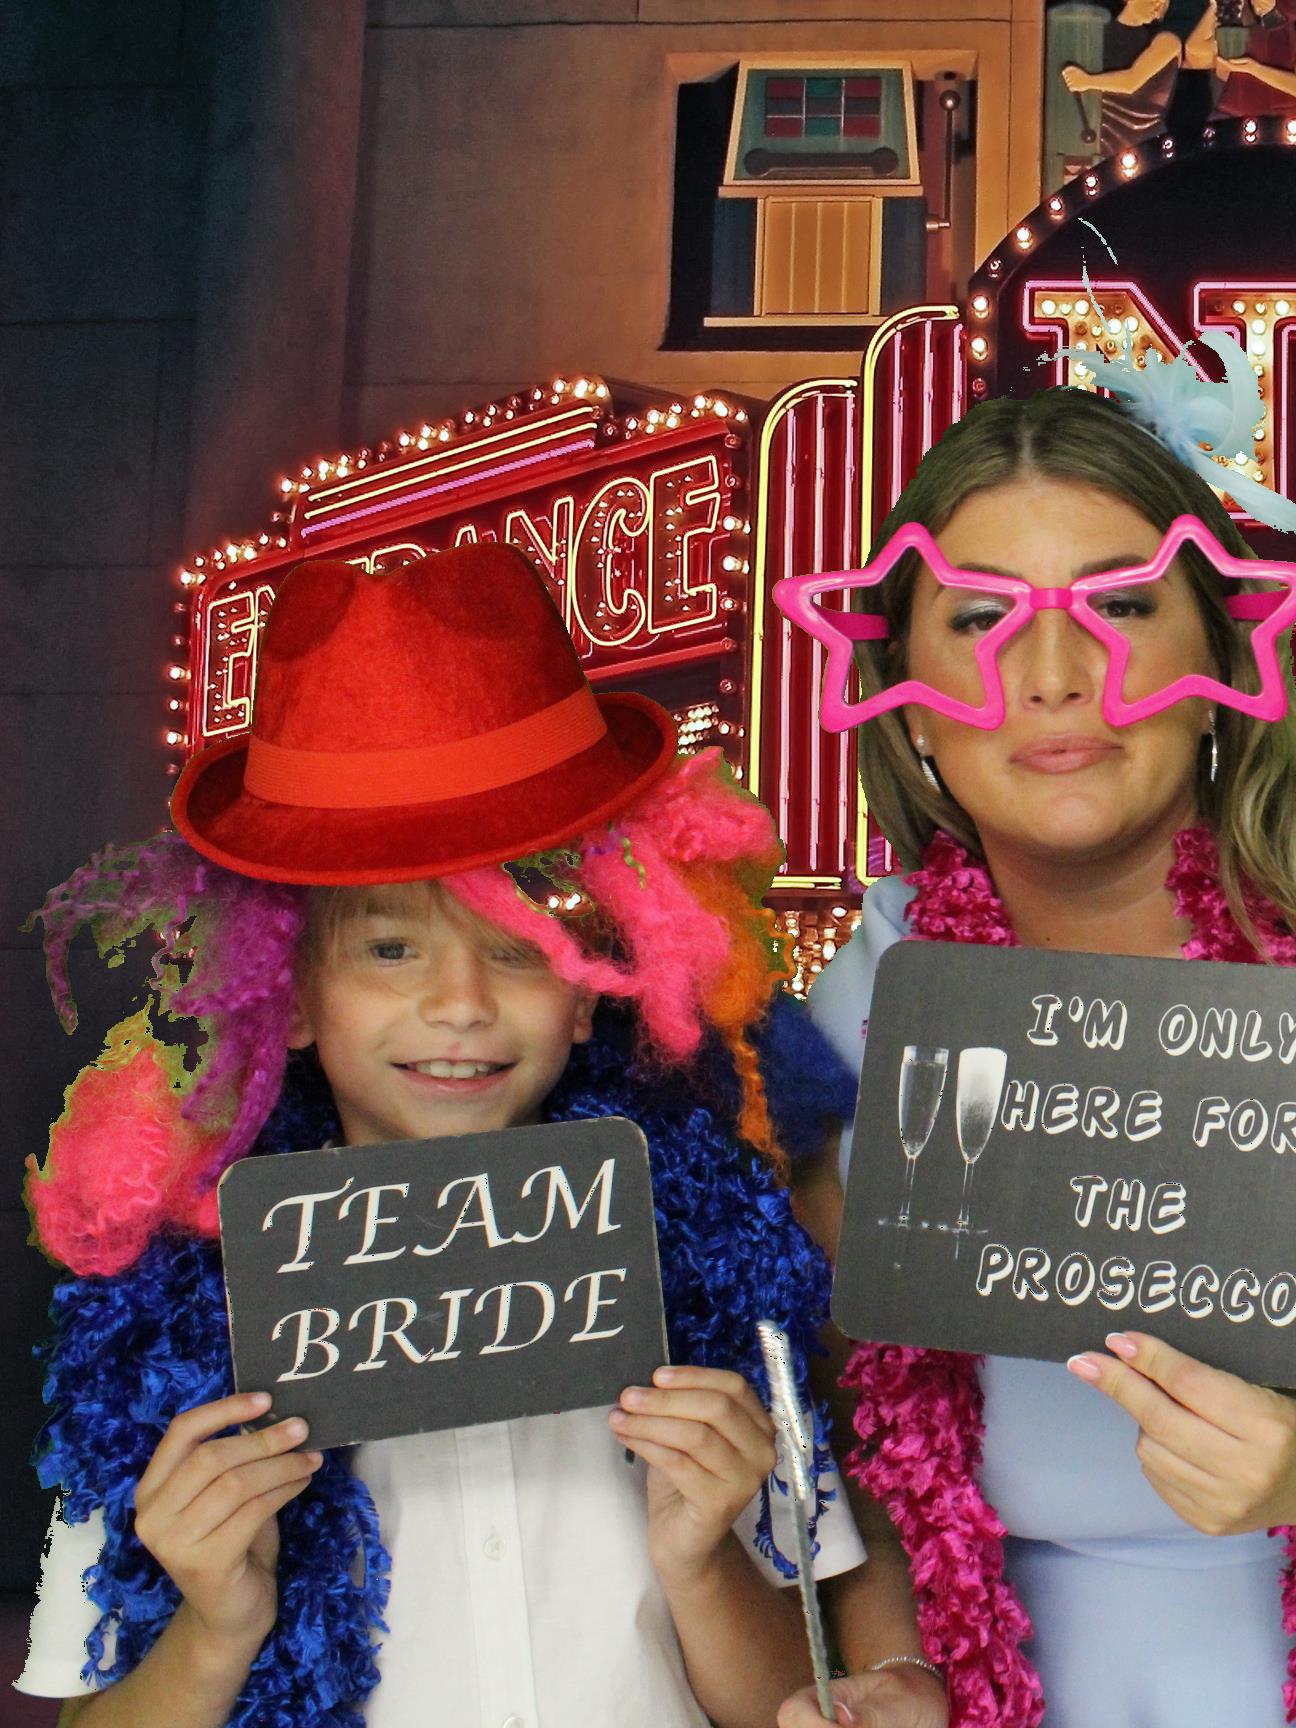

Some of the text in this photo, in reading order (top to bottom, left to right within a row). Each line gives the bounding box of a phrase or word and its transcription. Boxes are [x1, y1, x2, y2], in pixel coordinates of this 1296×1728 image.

[1026, 993, 1129, 1050] I'M
[1000, 1080, 1164, 1143] HERE
[261, 1157, 623, 1275] TEAM
[1069, 1174, 1189, 1235] THE
[270, 1267, 628, 1383] BRIDE
